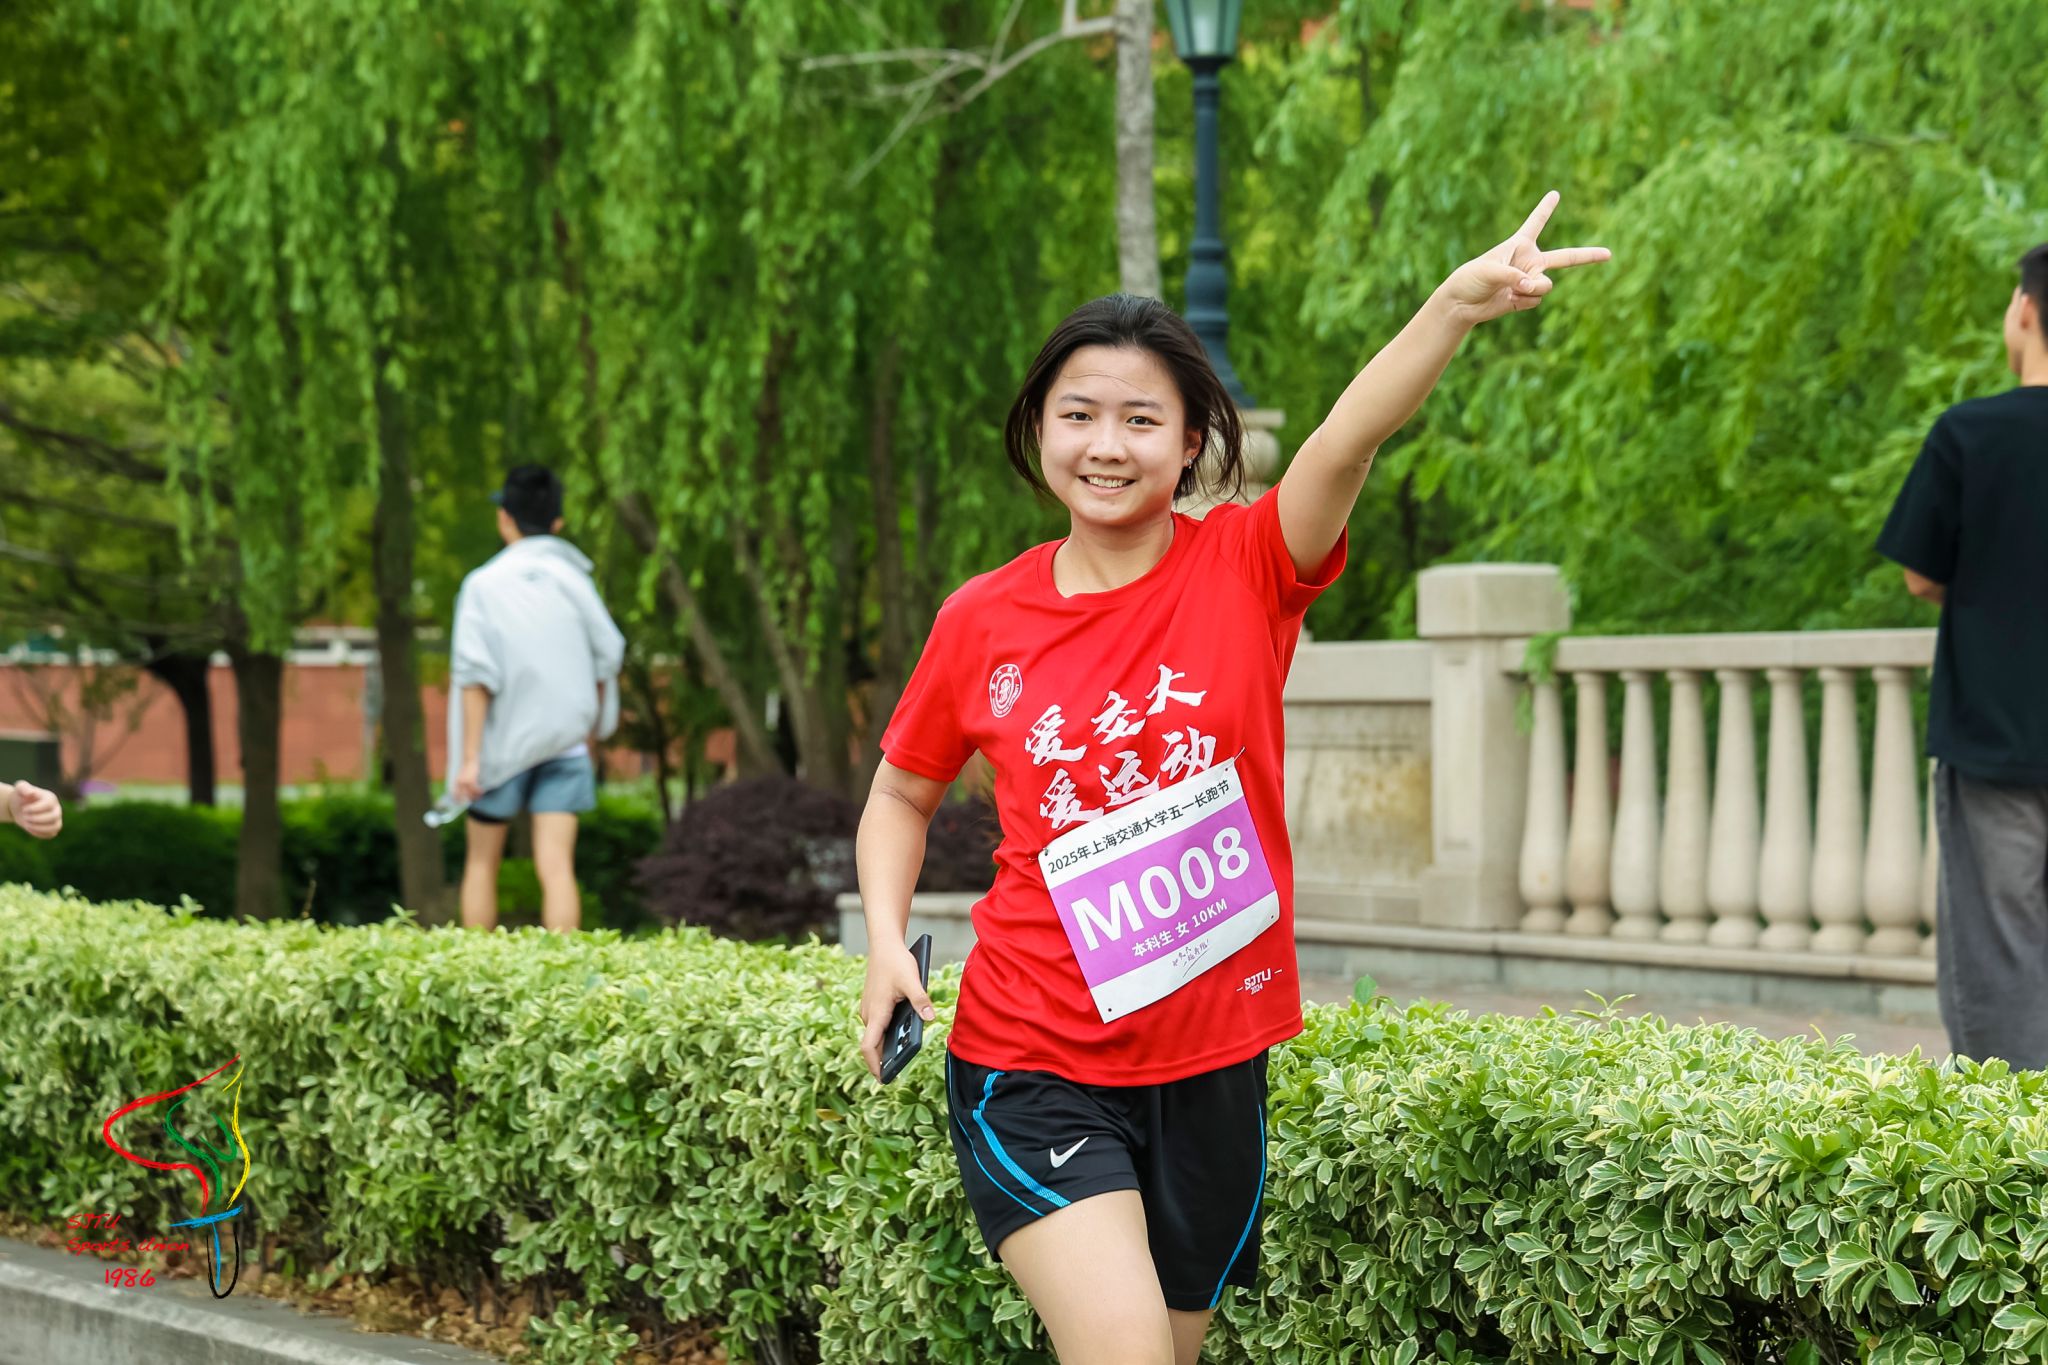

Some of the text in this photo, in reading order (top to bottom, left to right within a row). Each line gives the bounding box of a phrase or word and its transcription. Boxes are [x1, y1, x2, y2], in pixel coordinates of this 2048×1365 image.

[1025, 664, 1207, 767] 爱交大
[1039, 725, 1217, 831] 爱运动
[1047, 779, 1230, 874] 2025年上海交通大学五一长跑节
[1070, 826, 1250, 952] M008
[1132, 897, 1229, 958] 本科生 女 10KM
[1243, 967, 1272, 991] SJTU
